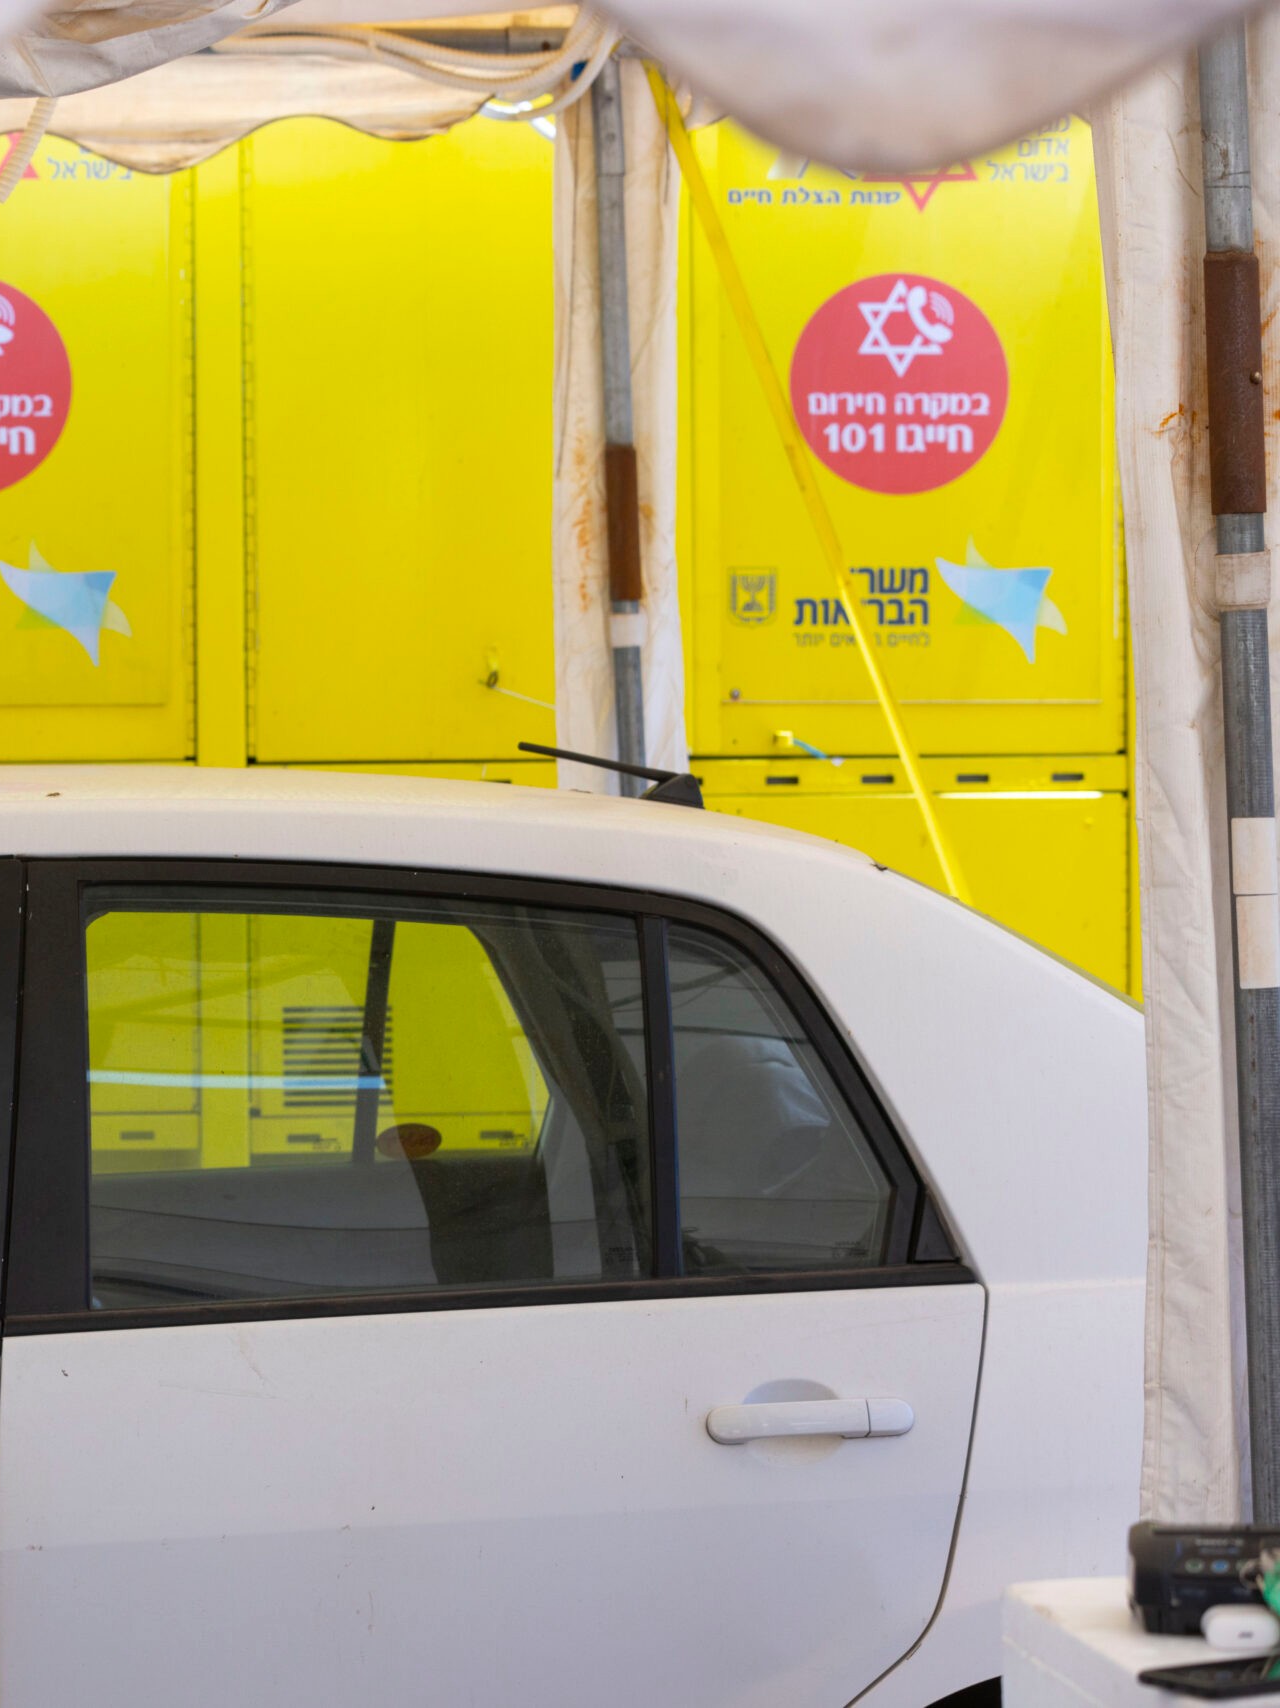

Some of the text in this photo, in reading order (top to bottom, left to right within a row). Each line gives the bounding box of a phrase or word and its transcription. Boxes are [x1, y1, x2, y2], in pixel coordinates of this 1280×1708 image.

[1017, 137, 1070, 157] אדום
[985, 159, 1069, 182] בישראל
[727, 186, 901, 204] שנות הצלת חיים
[807, 392, 990, 420] במקרה חירום
[823, 422, 974, 453] חייגו 101
[849, 567, 929, 594] משר
[793, 598, 929, 625] הבראות
[793, 633, 825, 647] יותר
[887, 630, 930, 647] לחיים
